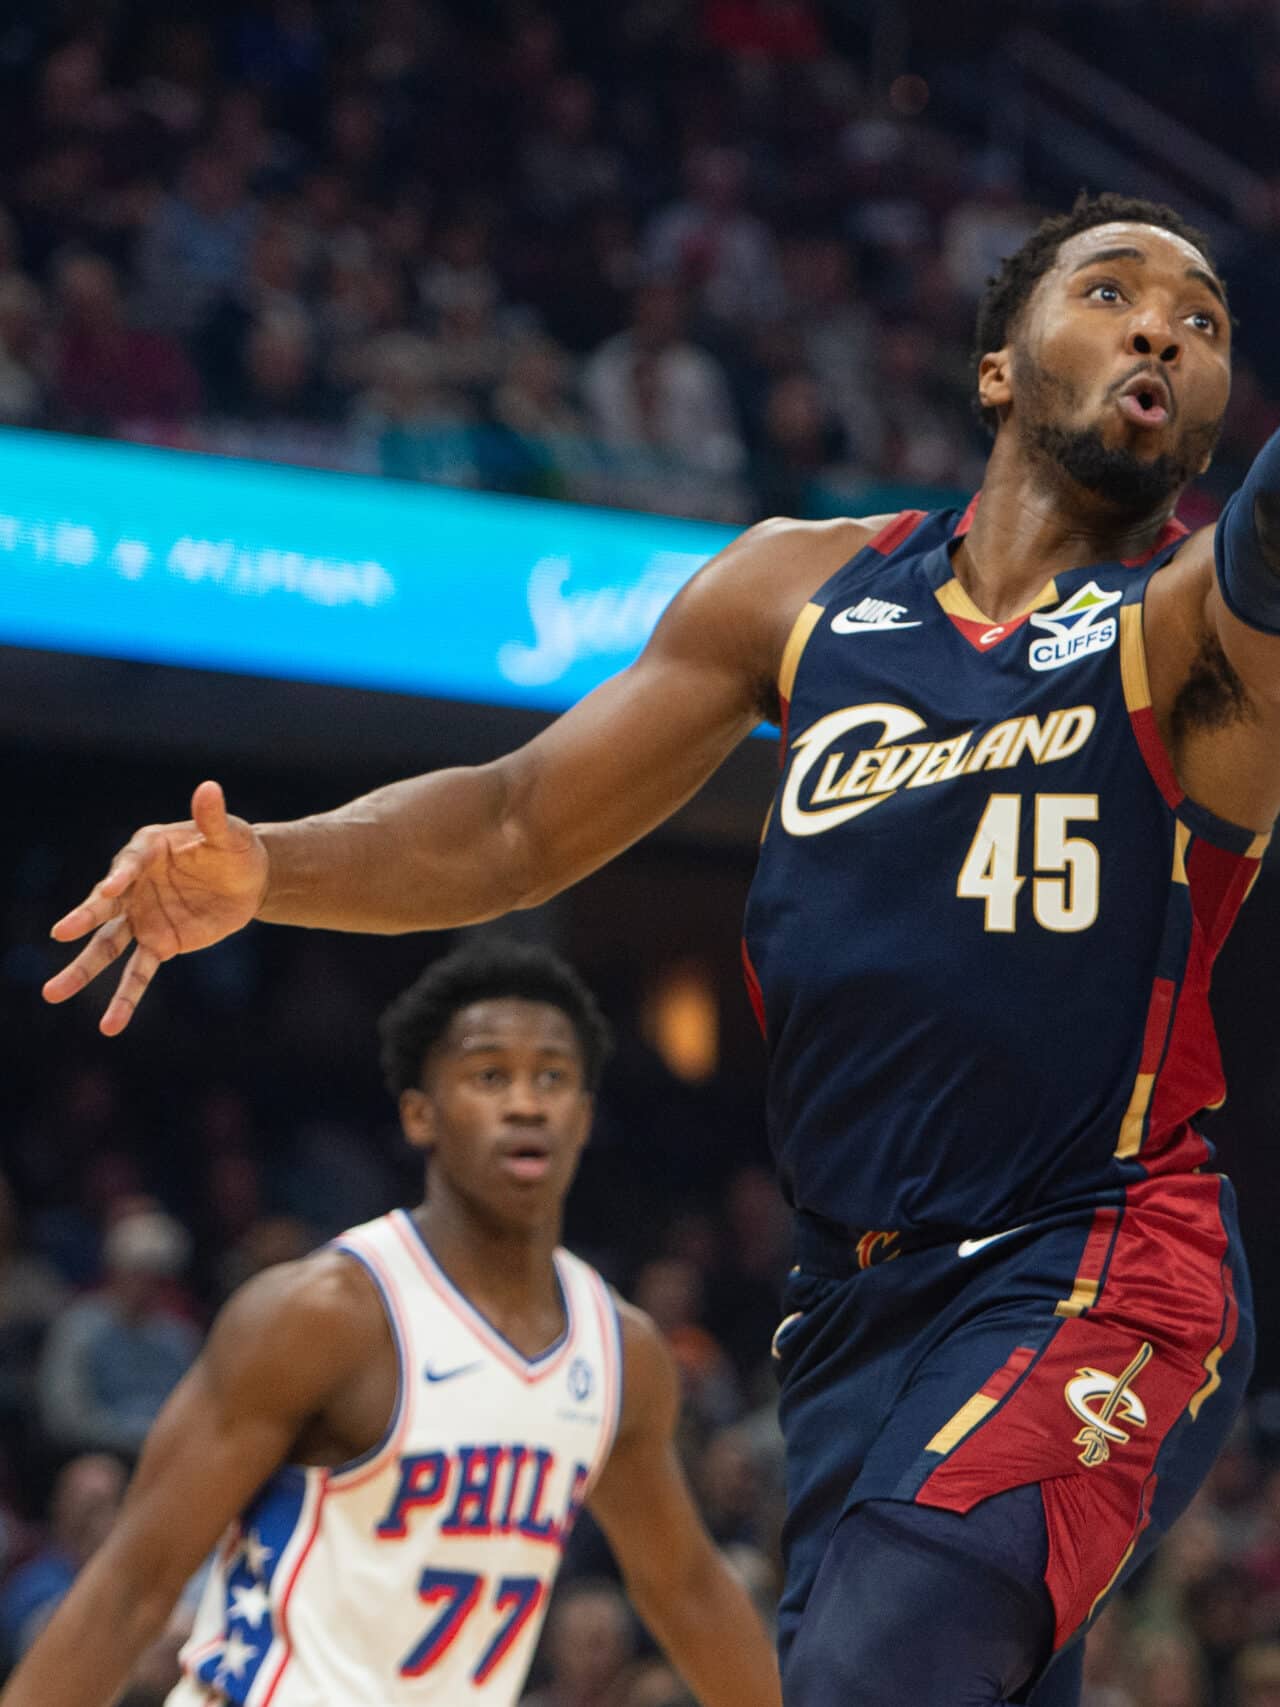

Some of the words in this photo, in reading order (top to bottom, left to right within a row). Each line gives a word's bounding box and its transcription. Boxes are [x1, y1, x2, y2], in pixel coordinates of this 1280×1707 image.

[847, 596, 909, 623] NIKE
[1033, 624, 1113, 664] CLIFFS
[780, 702, 1097, 838] CLEVELAND
[956, 793, 1100, 934] 45
[399, 1566, 546, 1688] 77
